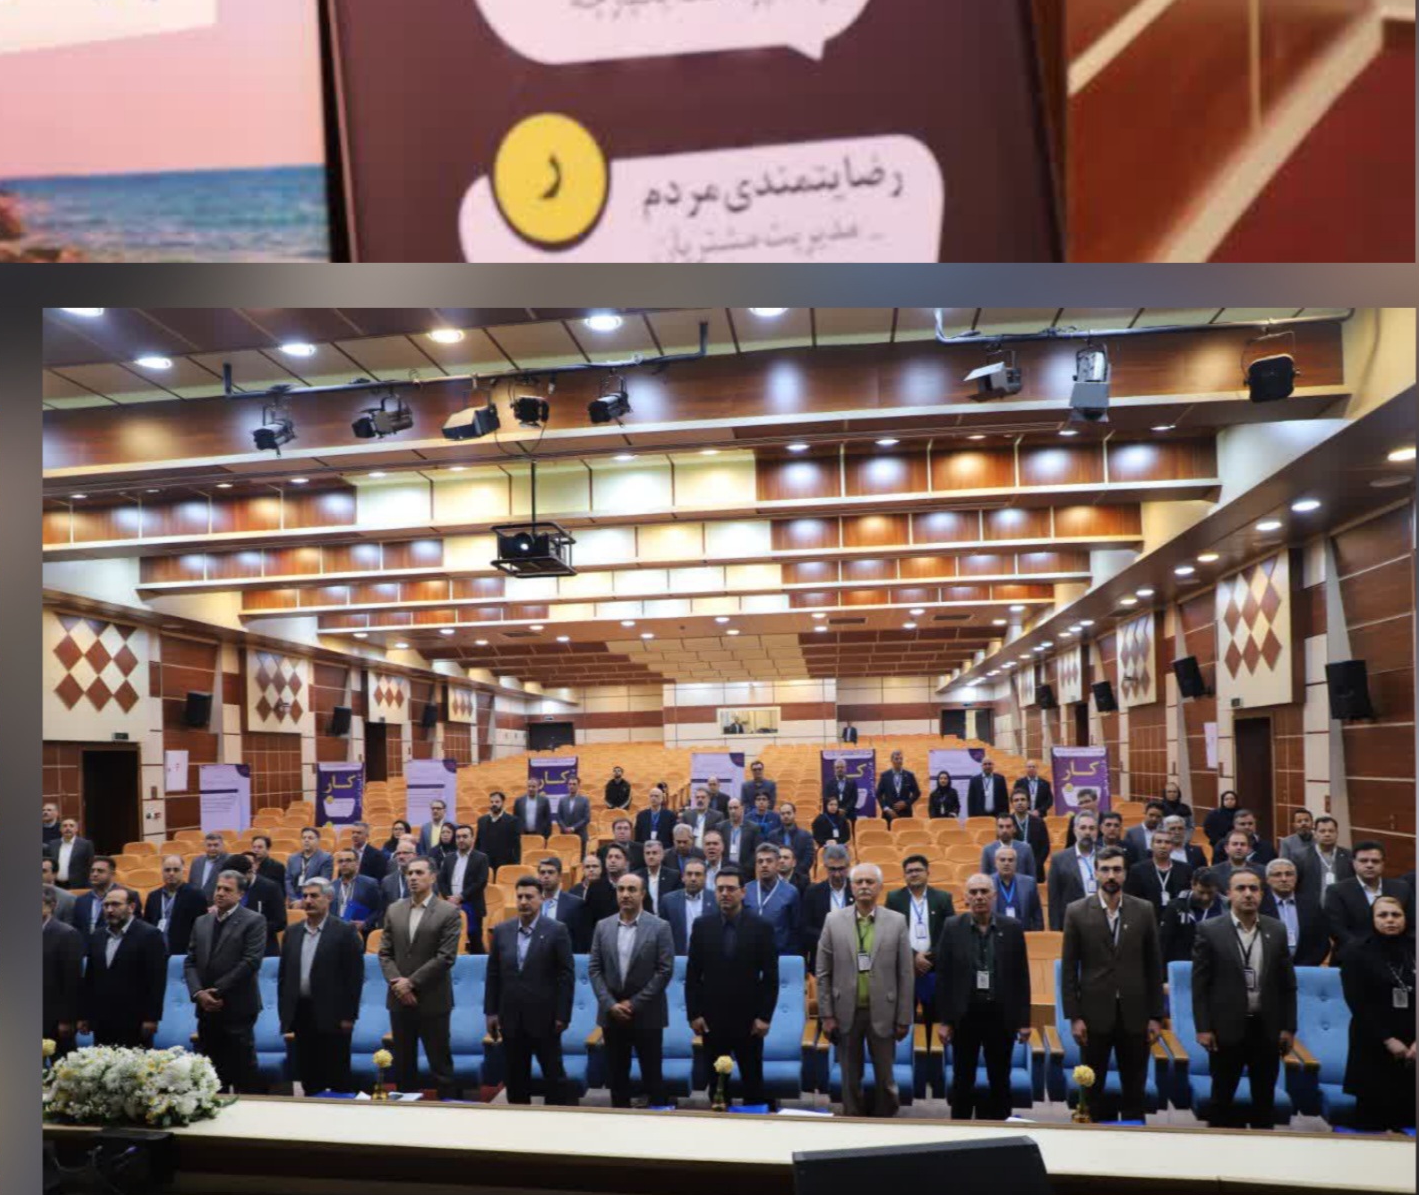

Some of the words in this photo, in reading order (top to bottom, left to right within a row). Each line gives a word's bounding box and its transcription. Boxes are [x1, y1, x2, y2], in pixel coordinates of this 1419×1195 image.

[538, 154, 562, 201] ر
[643, 179, 720, 220] مردم
[322, 774, 357, 794] کار
[1061, 758, 1100, 781] کار
